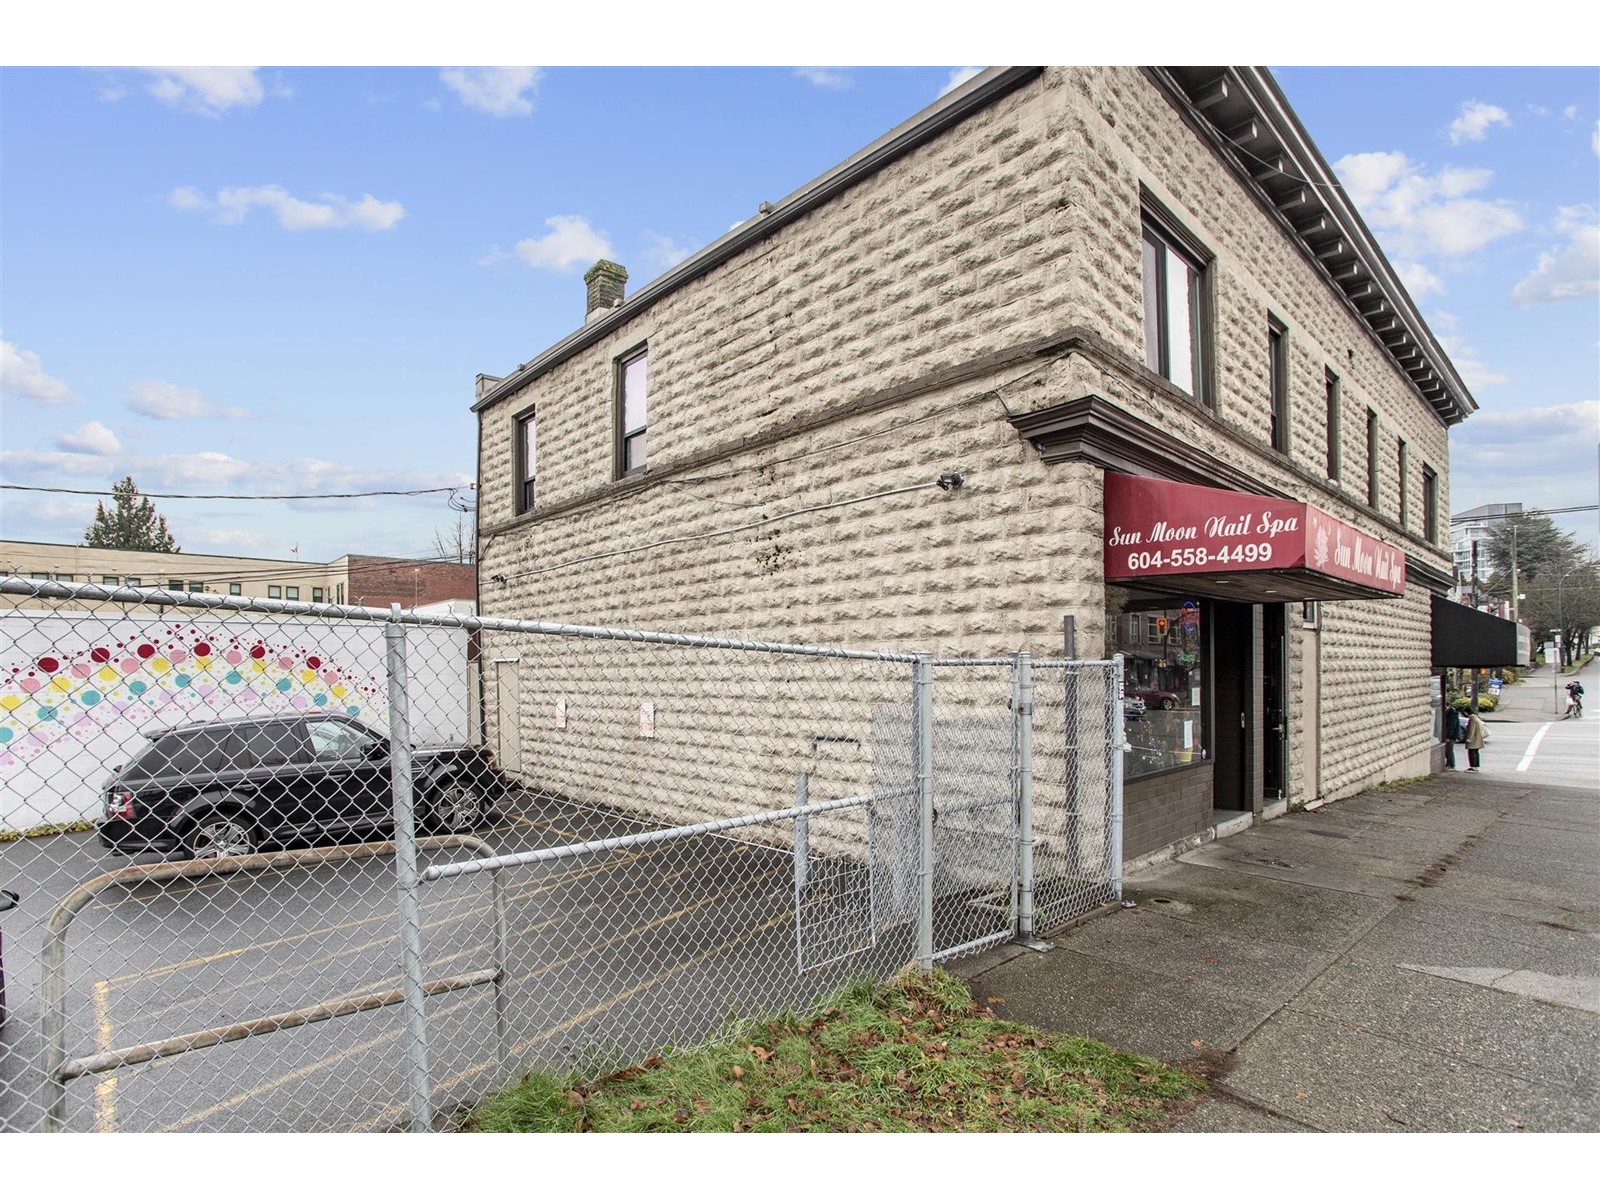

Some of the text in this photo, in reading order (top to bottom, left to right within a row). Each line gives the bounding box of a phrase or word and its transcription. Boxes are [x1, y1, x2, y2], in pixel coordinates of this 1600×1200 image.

[1109, 511, 1299, 547] Sun Moon Nail Spa
[1127, 543, 1272, 570] 604-558-4499
[1334, 527, 1351, 569] Sun
